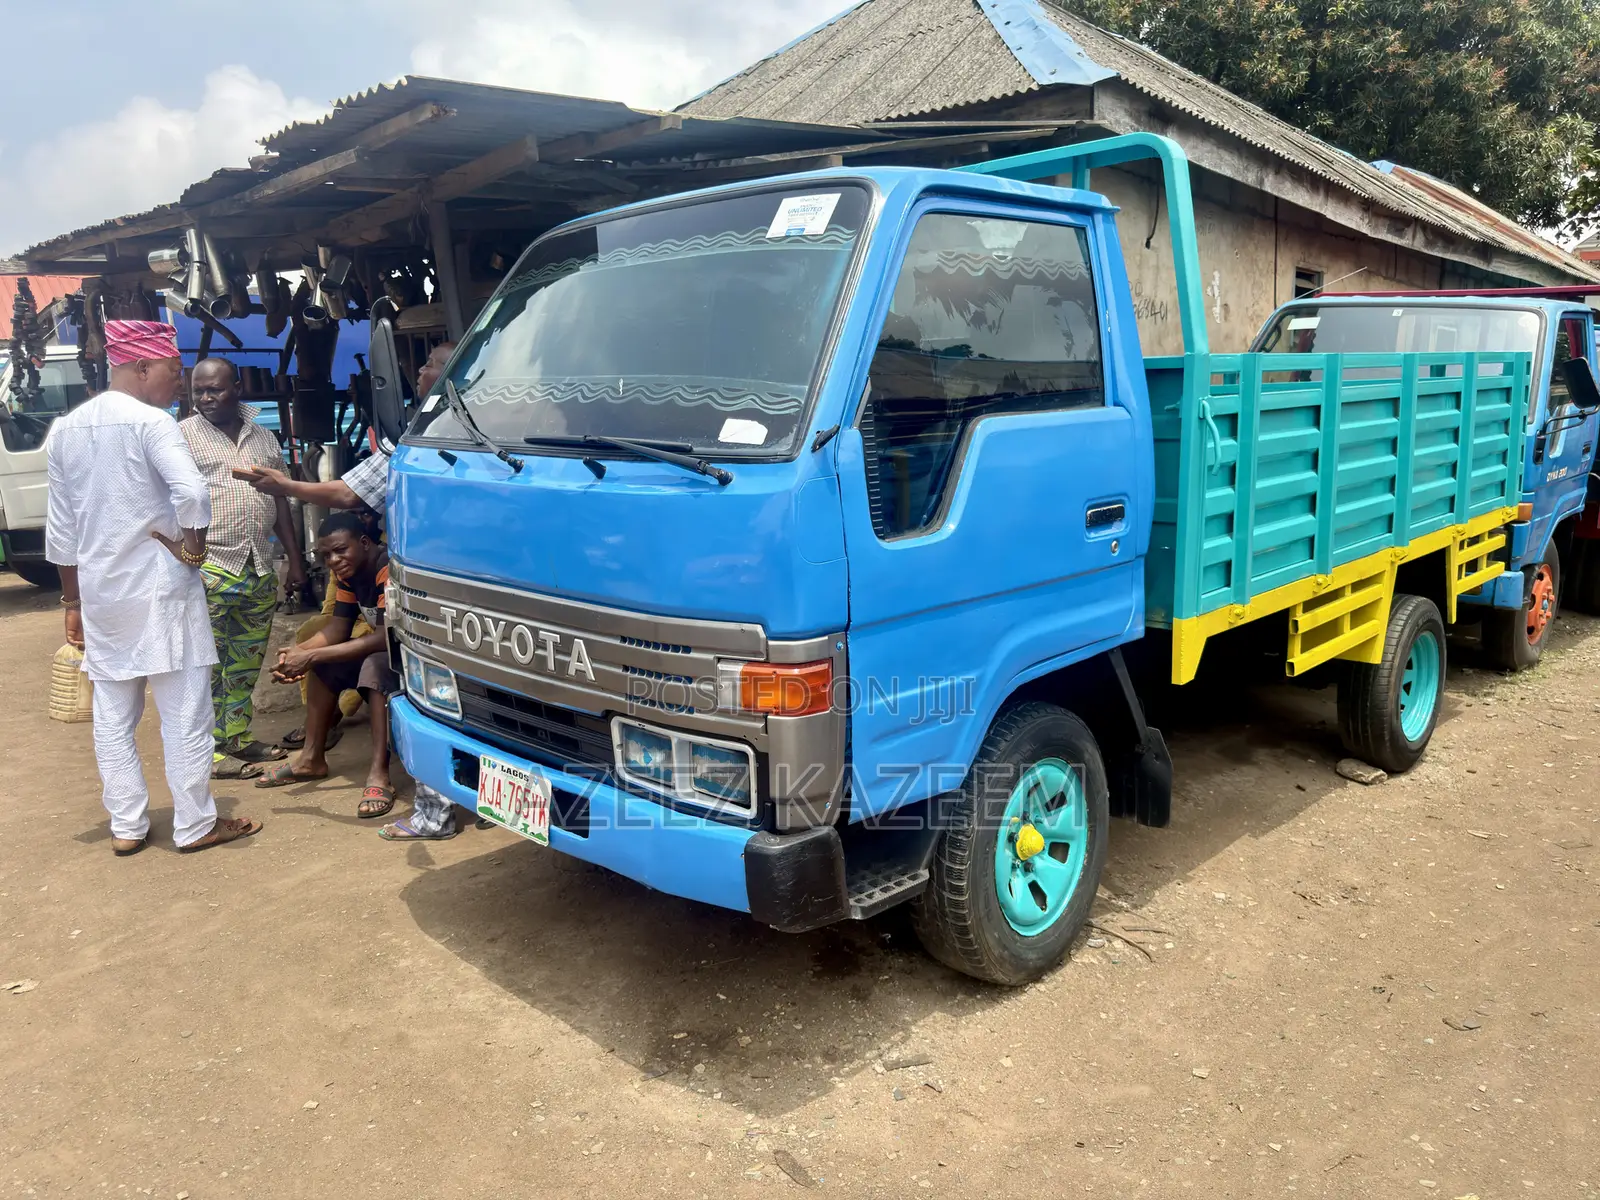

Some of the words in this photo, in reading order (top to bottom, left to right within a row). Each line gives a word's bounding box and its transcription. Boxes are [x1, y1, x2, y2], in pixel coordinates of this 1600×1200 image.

[787, 206, 823, 214] UNLIMITED
[439, 606, 596, 682] TOYOTA
[501, 765, 529, 782] LAGOS
